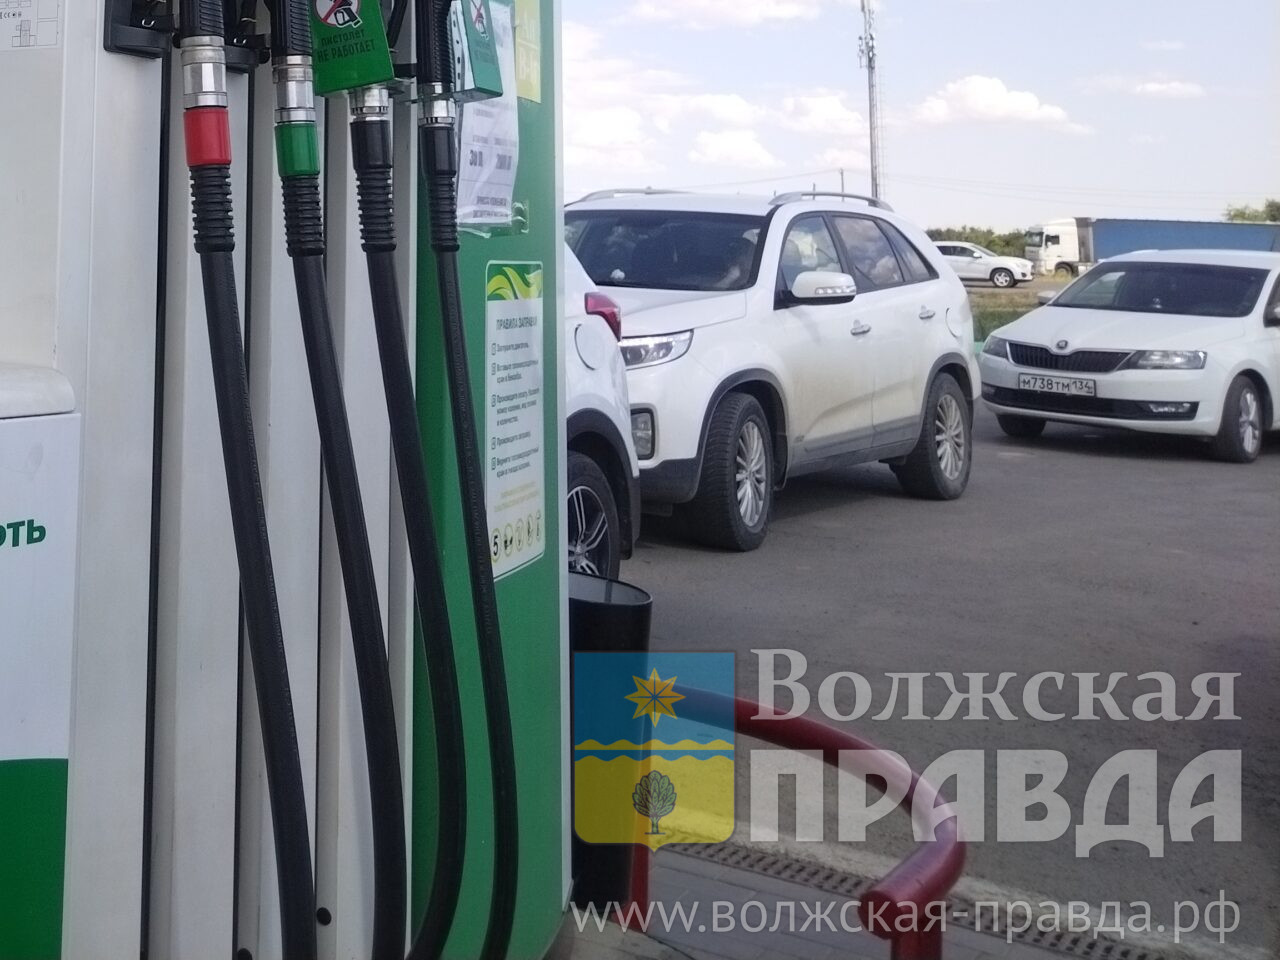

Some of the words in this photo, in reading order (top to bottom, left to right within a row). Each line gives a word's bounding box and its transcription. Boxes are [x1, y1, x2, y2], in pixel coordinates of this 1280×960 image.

[1022, 376, 1070, 392] М738ТМ
[1072, 380, 1093, 391] 134
[493, 534, 499, 557] 5
